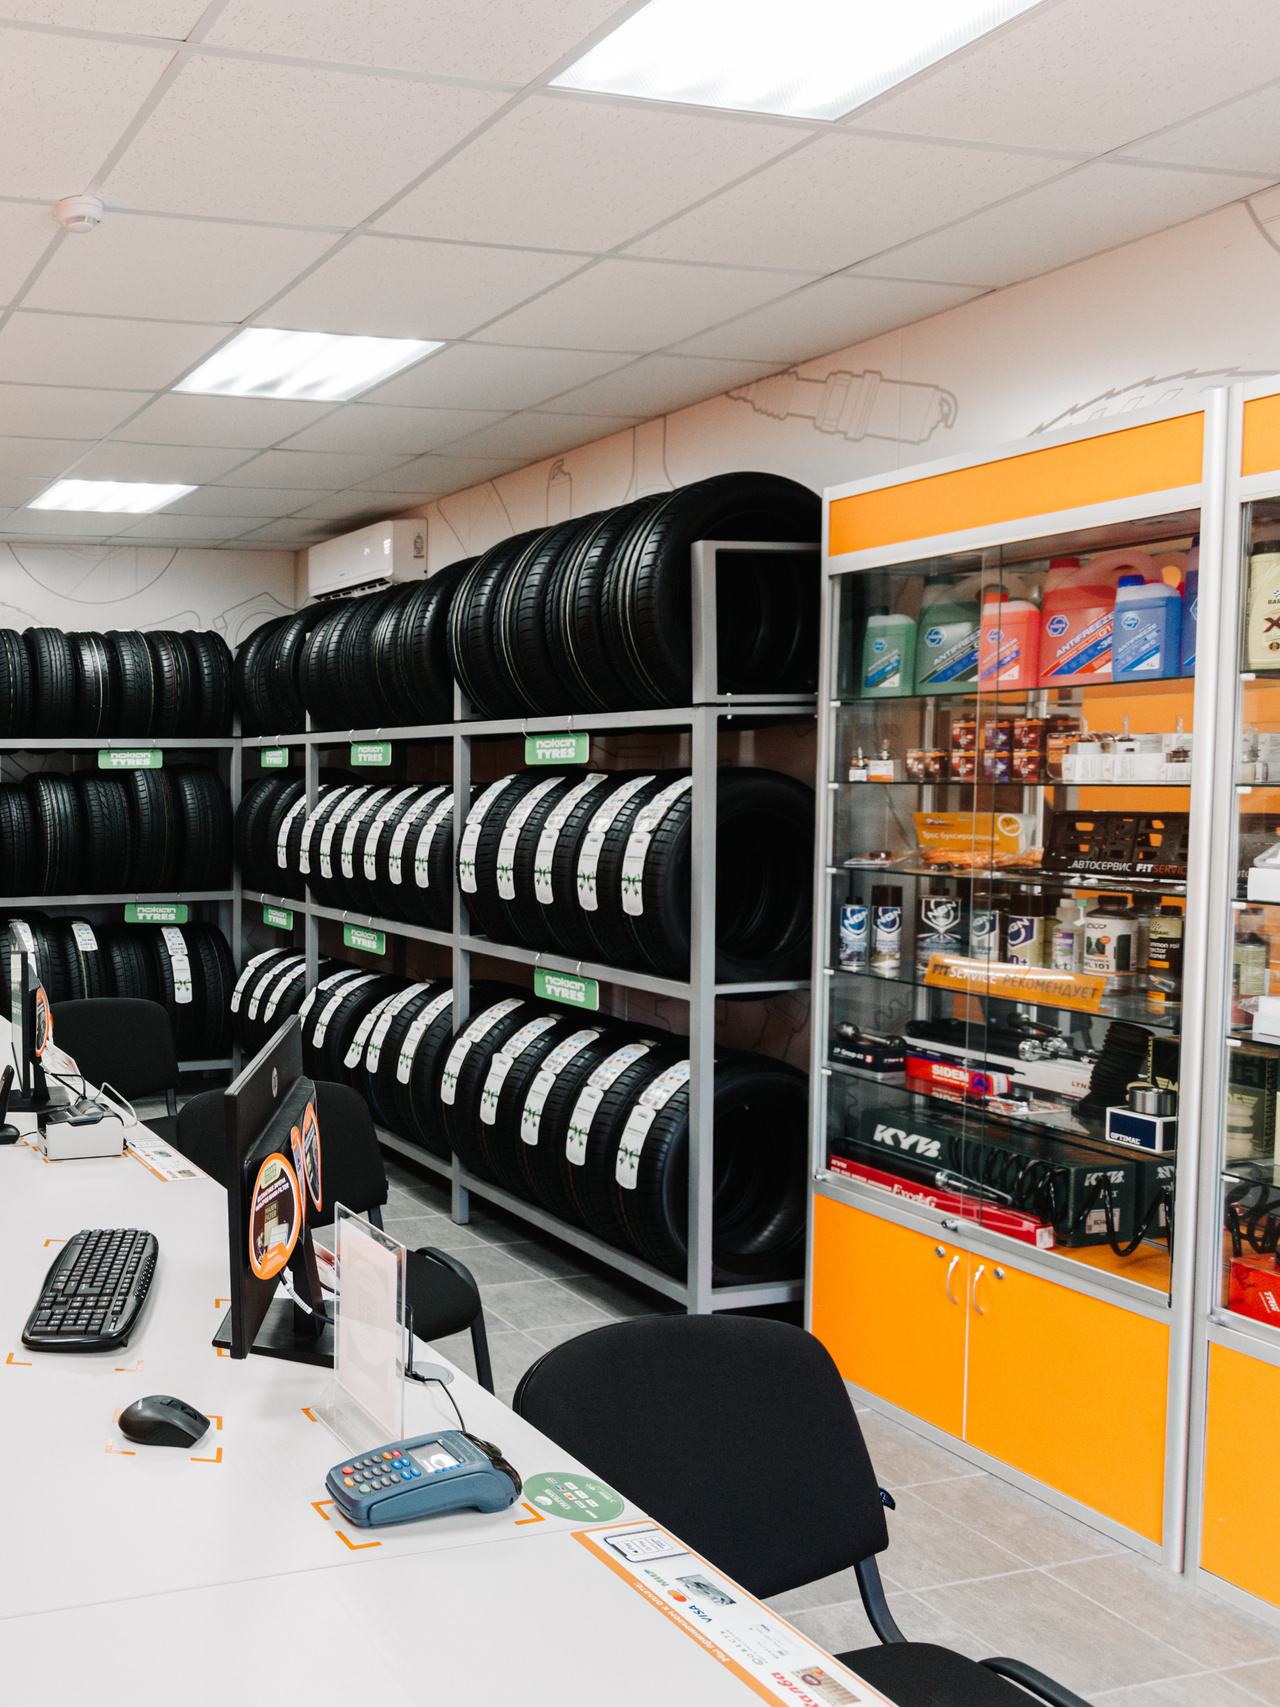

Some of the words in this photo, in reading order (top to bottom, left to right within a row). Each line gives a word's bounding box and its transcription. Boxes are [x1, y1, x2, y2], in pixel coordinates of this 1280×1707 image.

[266, 756, 283, 764] TYRES
[358, 753, 382, 762] TYRES
[536, 748, 575, 759] TYRES
[1071, 860, 1132, 872] АВТОСЕРВИС
[1152, 864, 1186, 875] SERVIC
[268, 914, 287, 926] TYRES
[351, 936, 377, 950] TYRES
[949, 965, 997, 985] SERVICE
[545, 985, 585, 1003] TYRES
[1002, 974, 1099, 1001] РЕКОМЕНДУЕТ
[873, 1123, 941, 1158] KYB
[893, 1183, 937, 1209] Excel-G
[689, 1605, 712, 1623] VISA
[667, 1611, 714, 1649] принимаем
[712, 1649, 730, 1662] Мы
